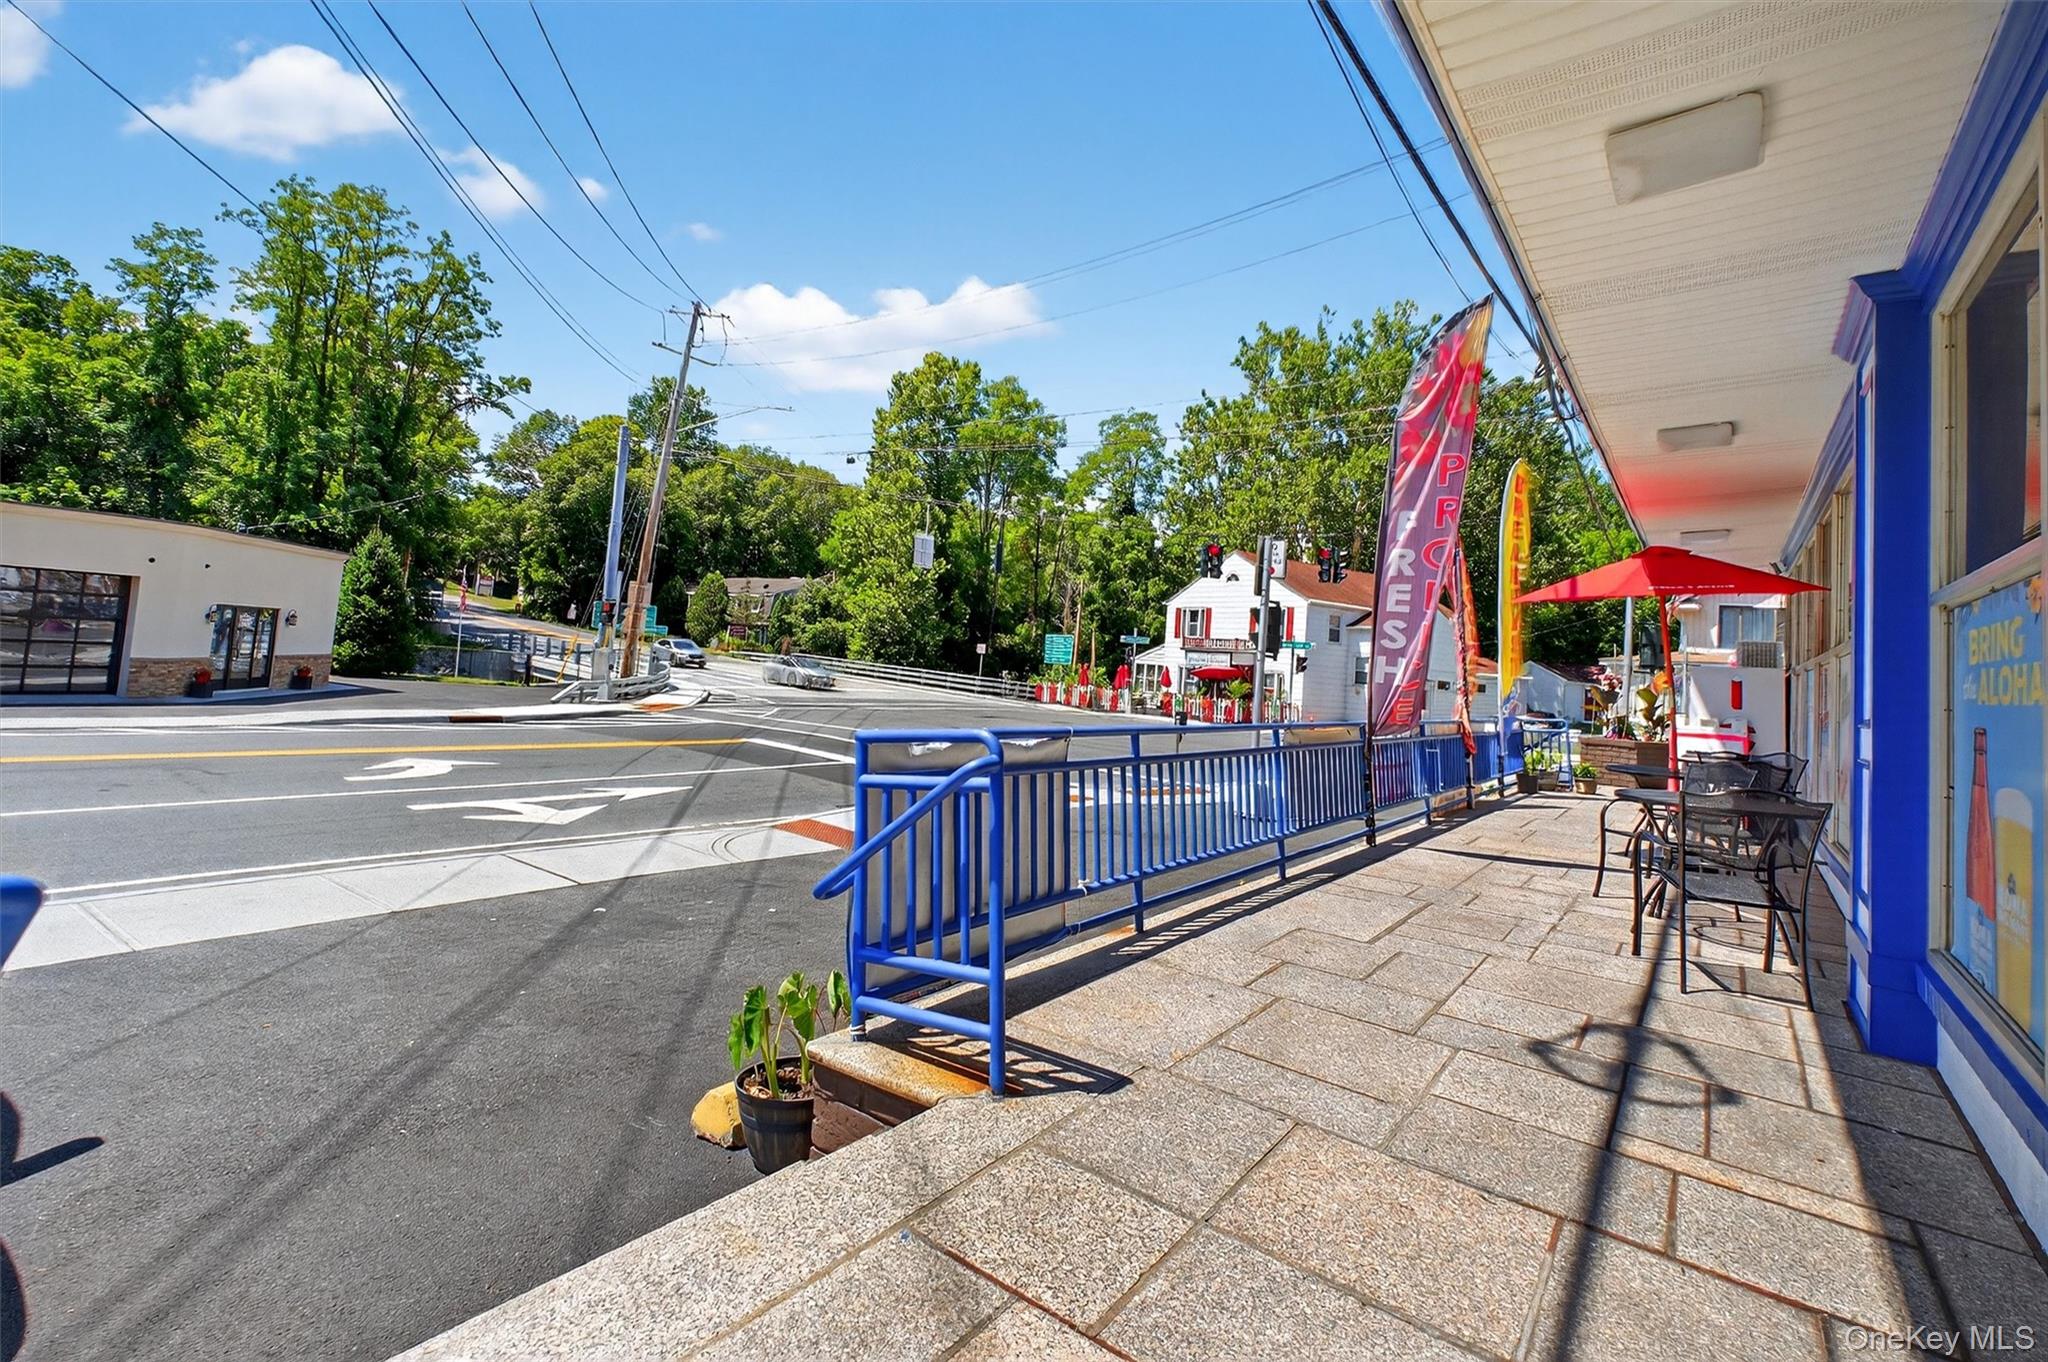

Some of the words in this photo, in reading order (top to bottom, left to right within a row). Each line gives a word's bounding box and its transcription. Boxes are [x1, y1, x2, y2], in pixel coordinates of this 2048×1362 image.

[1375, 510, 1417, 684] FRESH
[1968, 617, 2024, 665] BRING
[1978, 661, 2046, 705] ALOHA
